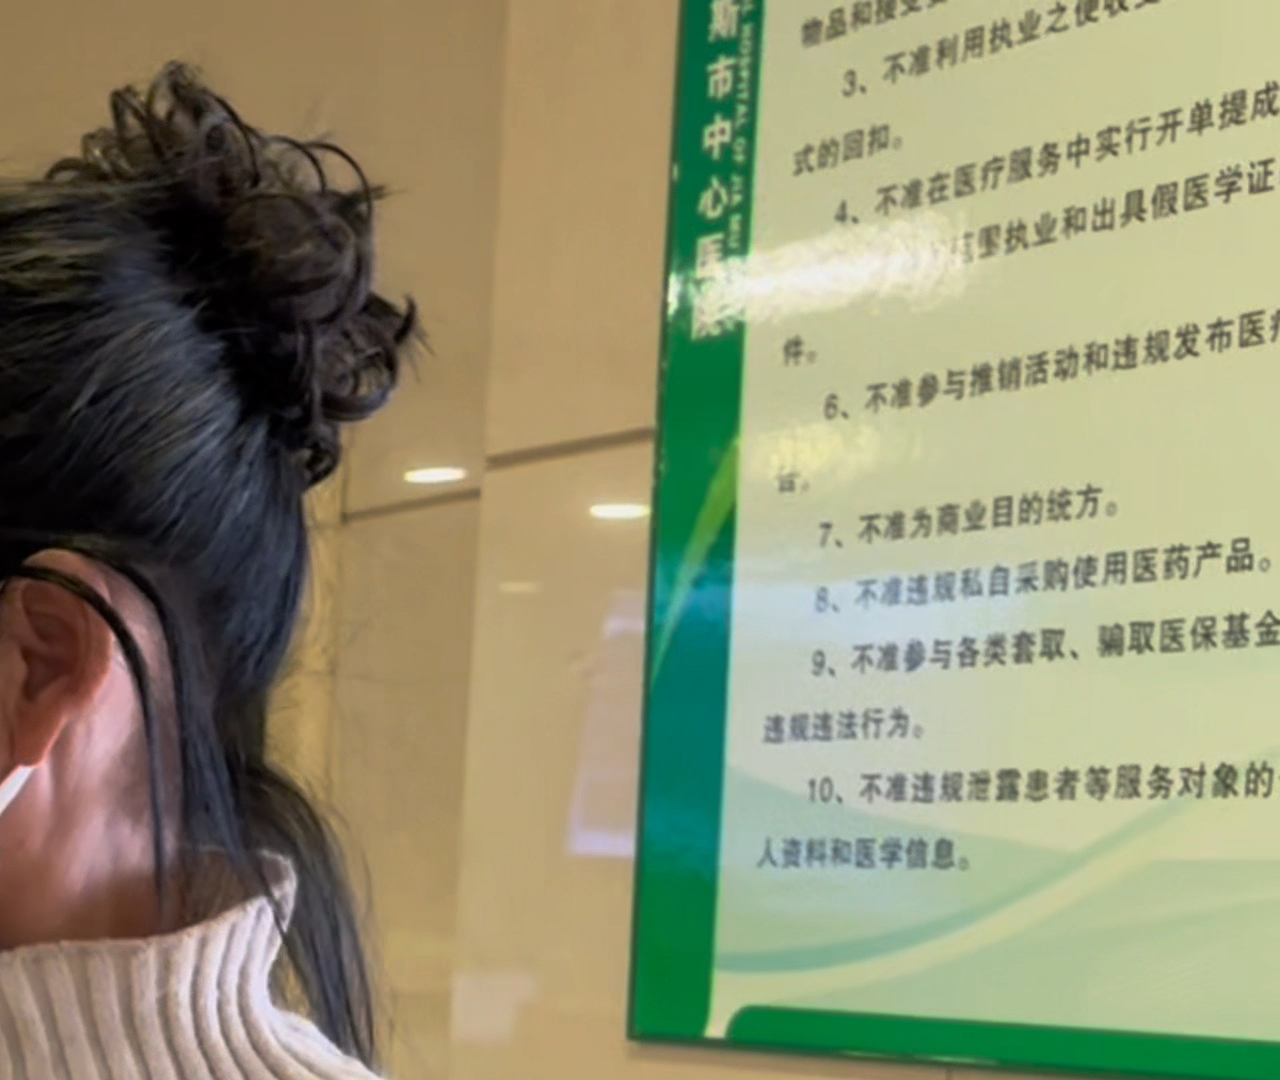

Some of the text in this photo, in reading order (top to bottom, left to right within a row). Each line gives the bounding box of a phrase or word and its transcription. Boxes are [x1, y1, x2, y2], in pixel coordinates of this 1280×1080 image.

[801, 0, 948, 48] 物品和接受
[841, 0, 1162, 97] 3、不准利用执业之便收
[792, 124, 904, 178] 式的回扣。
[819, 484, 1119, 549] 7、不准为商业目的统方。
[814, 537, 1272, 614] 8、不准违规私自采购使用医药产品。
[763, 707, 925, 745] 违规违法行为。
[808, 760, 1280, 807] 10、不准违规泄露患者等服务对象的
[756, 836, 971, 873] 人资料和医学信息。
